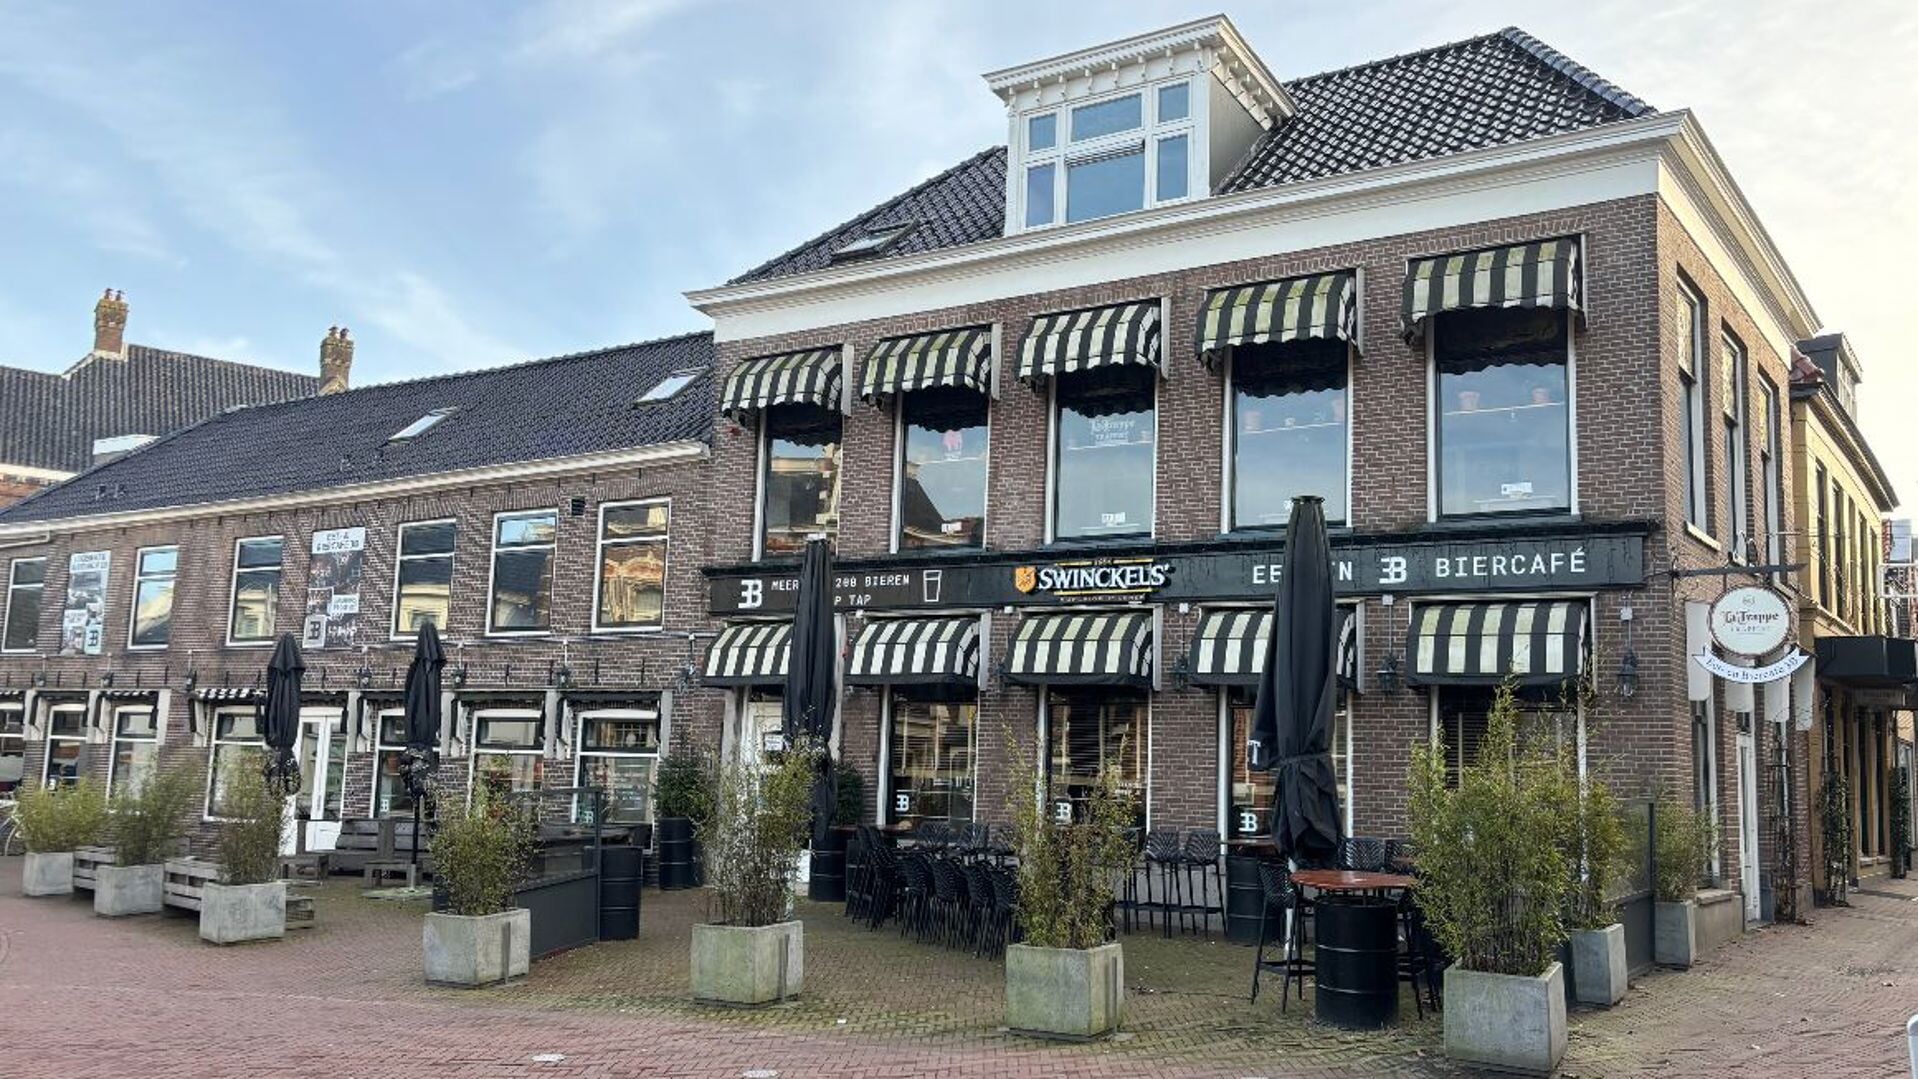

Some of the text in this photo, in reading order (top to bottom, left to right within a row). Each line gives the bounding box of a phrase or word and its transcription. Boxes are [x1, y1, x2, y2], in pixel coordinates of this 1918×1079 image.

[1435, 547, 1586, 578] BIERCAFÉ
[771, 579, 799, 591] MEER
[864, 574, 910, 588] BIEREN
[849, 594, 871, 606] TAP
